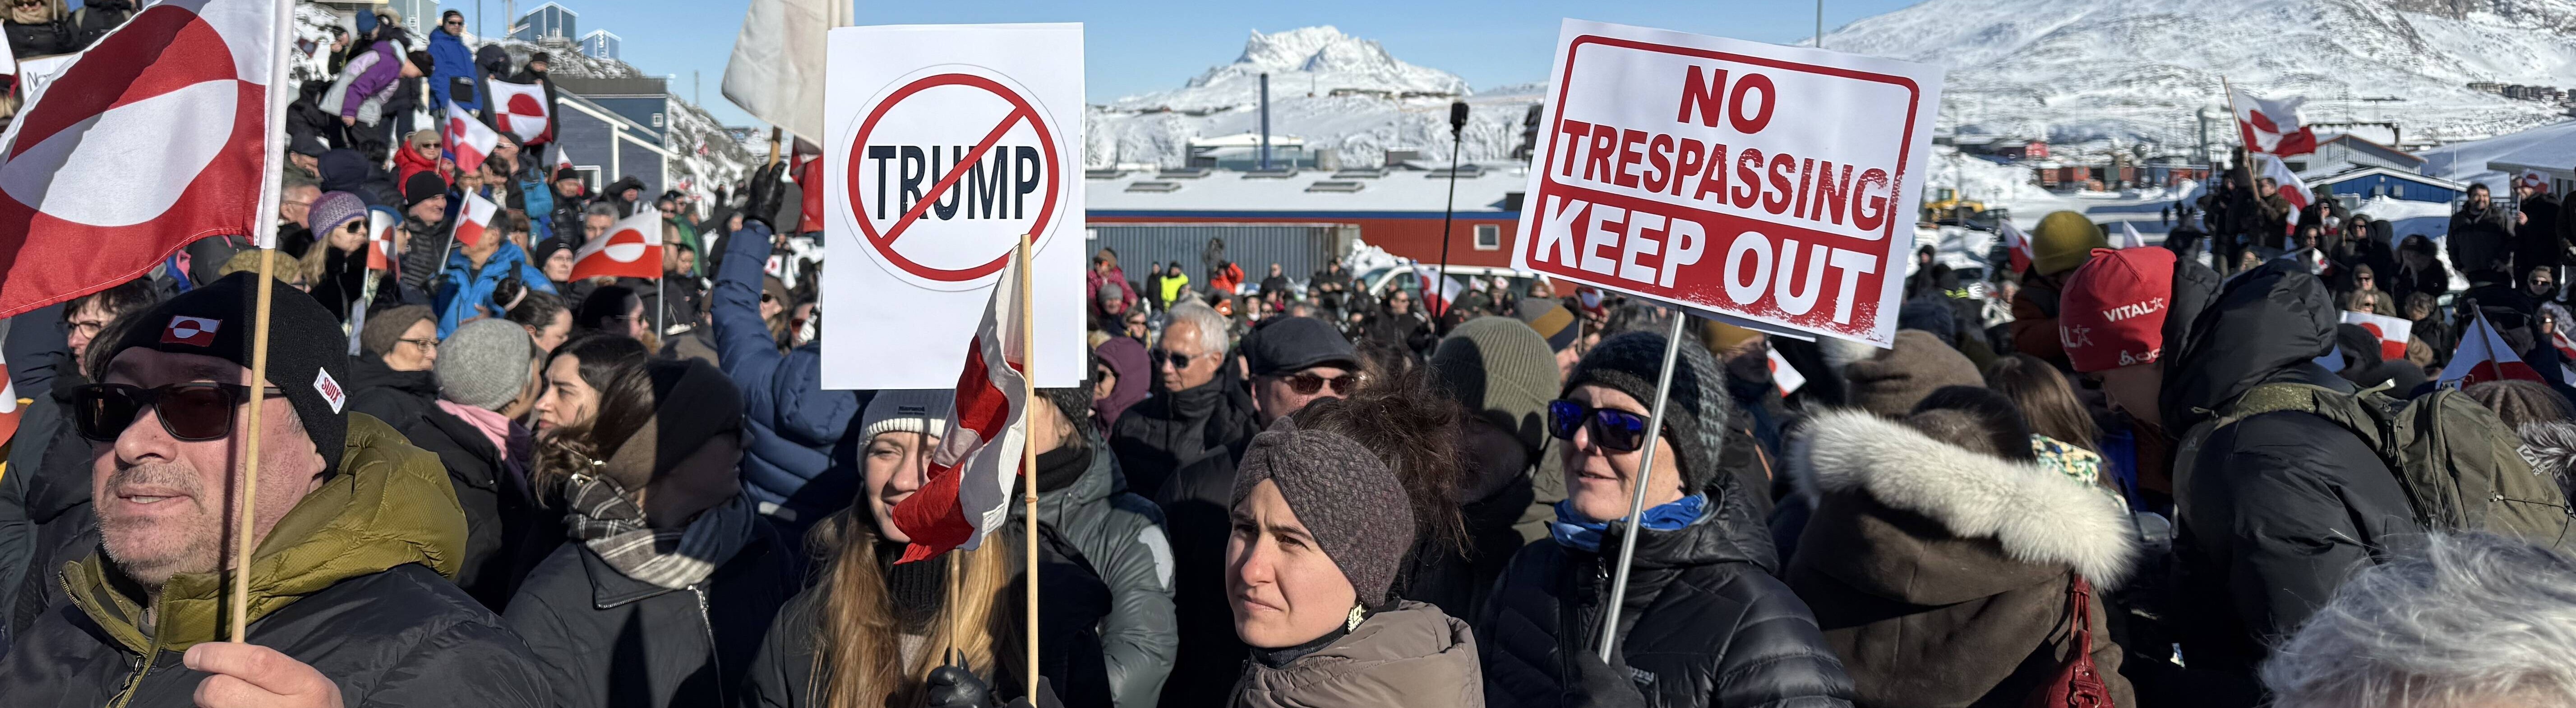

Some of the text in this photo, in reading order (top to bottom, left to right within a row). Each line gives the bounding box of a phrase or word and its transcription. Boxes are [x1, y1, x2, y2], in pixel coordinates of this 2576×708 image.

[1677, 65, 1776, 134] NO
[868, 145, 1041, 220] TRUMP
[1560, 119, 1888, 232] TRESPASSING
[1534, 194, 1878, 326] KEEP OUT
[2102, 301, 2154, 322] VITAL
